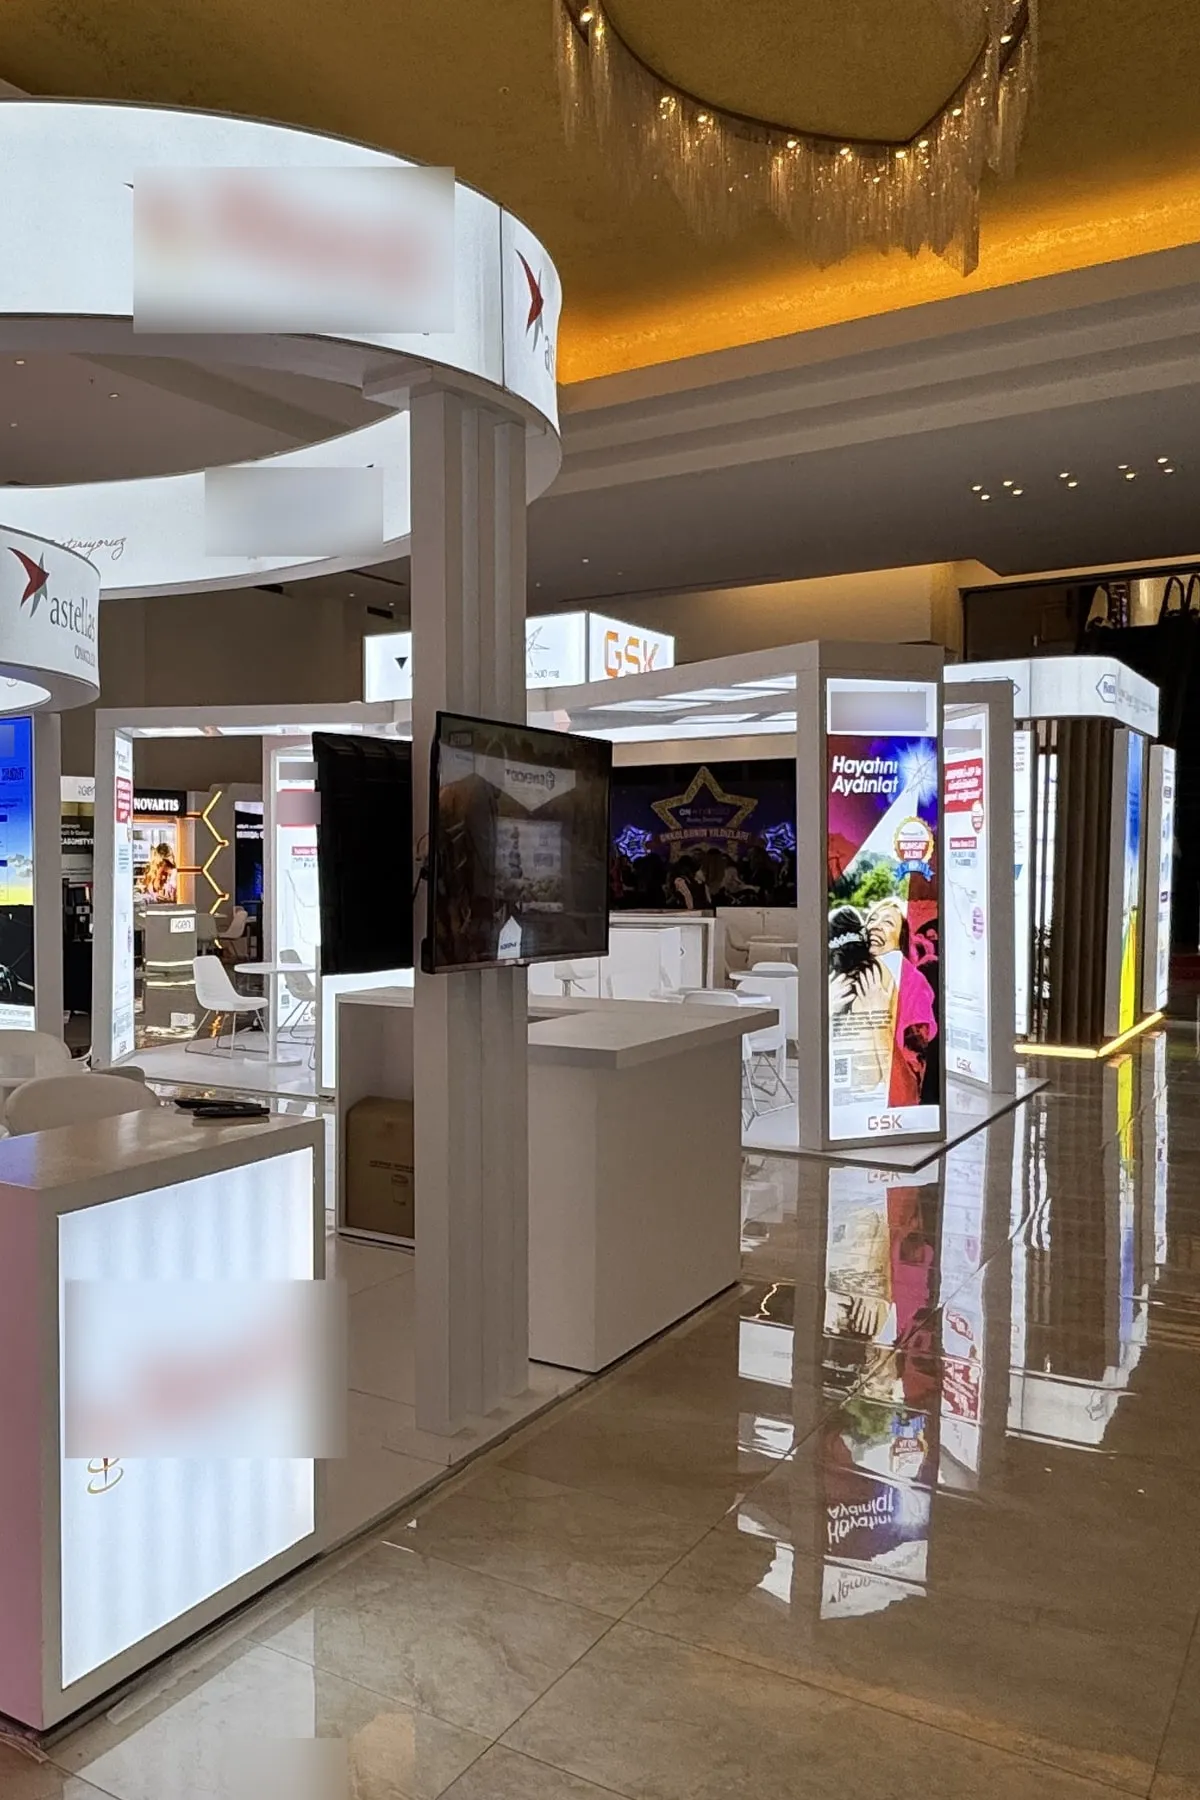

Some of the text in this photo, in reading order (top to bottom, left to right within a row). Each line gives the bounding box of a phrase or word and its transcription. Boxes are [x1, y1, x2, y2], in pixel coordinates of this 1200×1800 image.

[604, 630, 659, 680] GSK
[831, 755, 899, 777] Hayatını
[831, 774, 899, 797] Aydınlat
[134, 798, 180, 812] NOVARTIS
[867, 1114, 903, 1131] GSK
